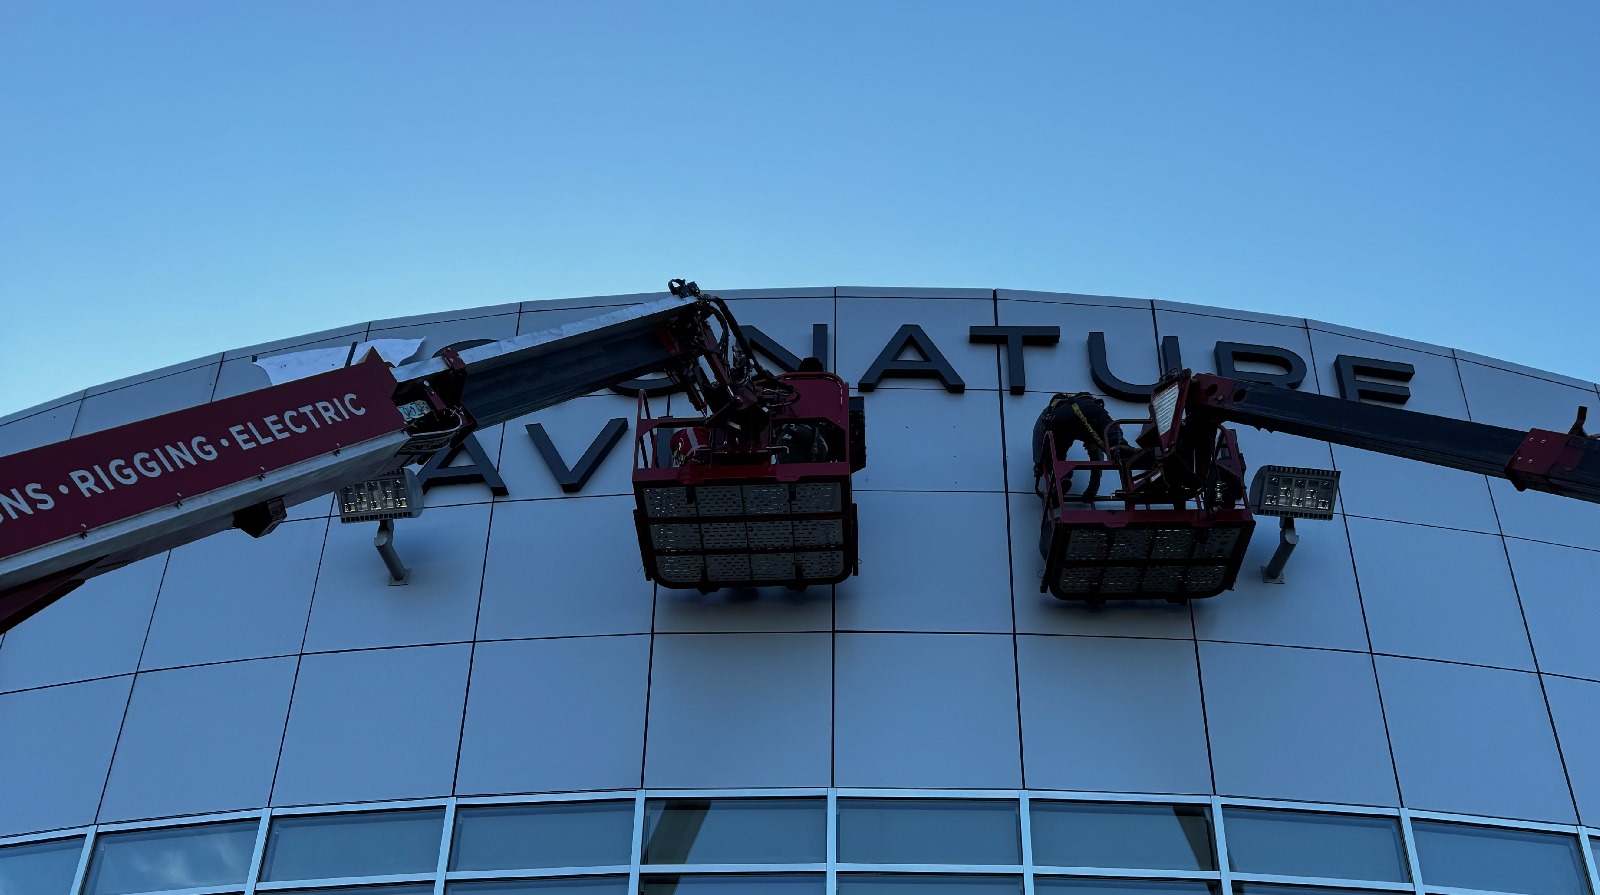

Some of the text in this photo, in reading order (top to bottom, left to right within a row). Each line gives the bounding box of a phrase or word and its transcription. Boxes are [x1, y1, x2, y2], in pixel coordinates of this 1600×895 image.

[0, 393, 367, 524] NS RIGGING ELECTRIC
